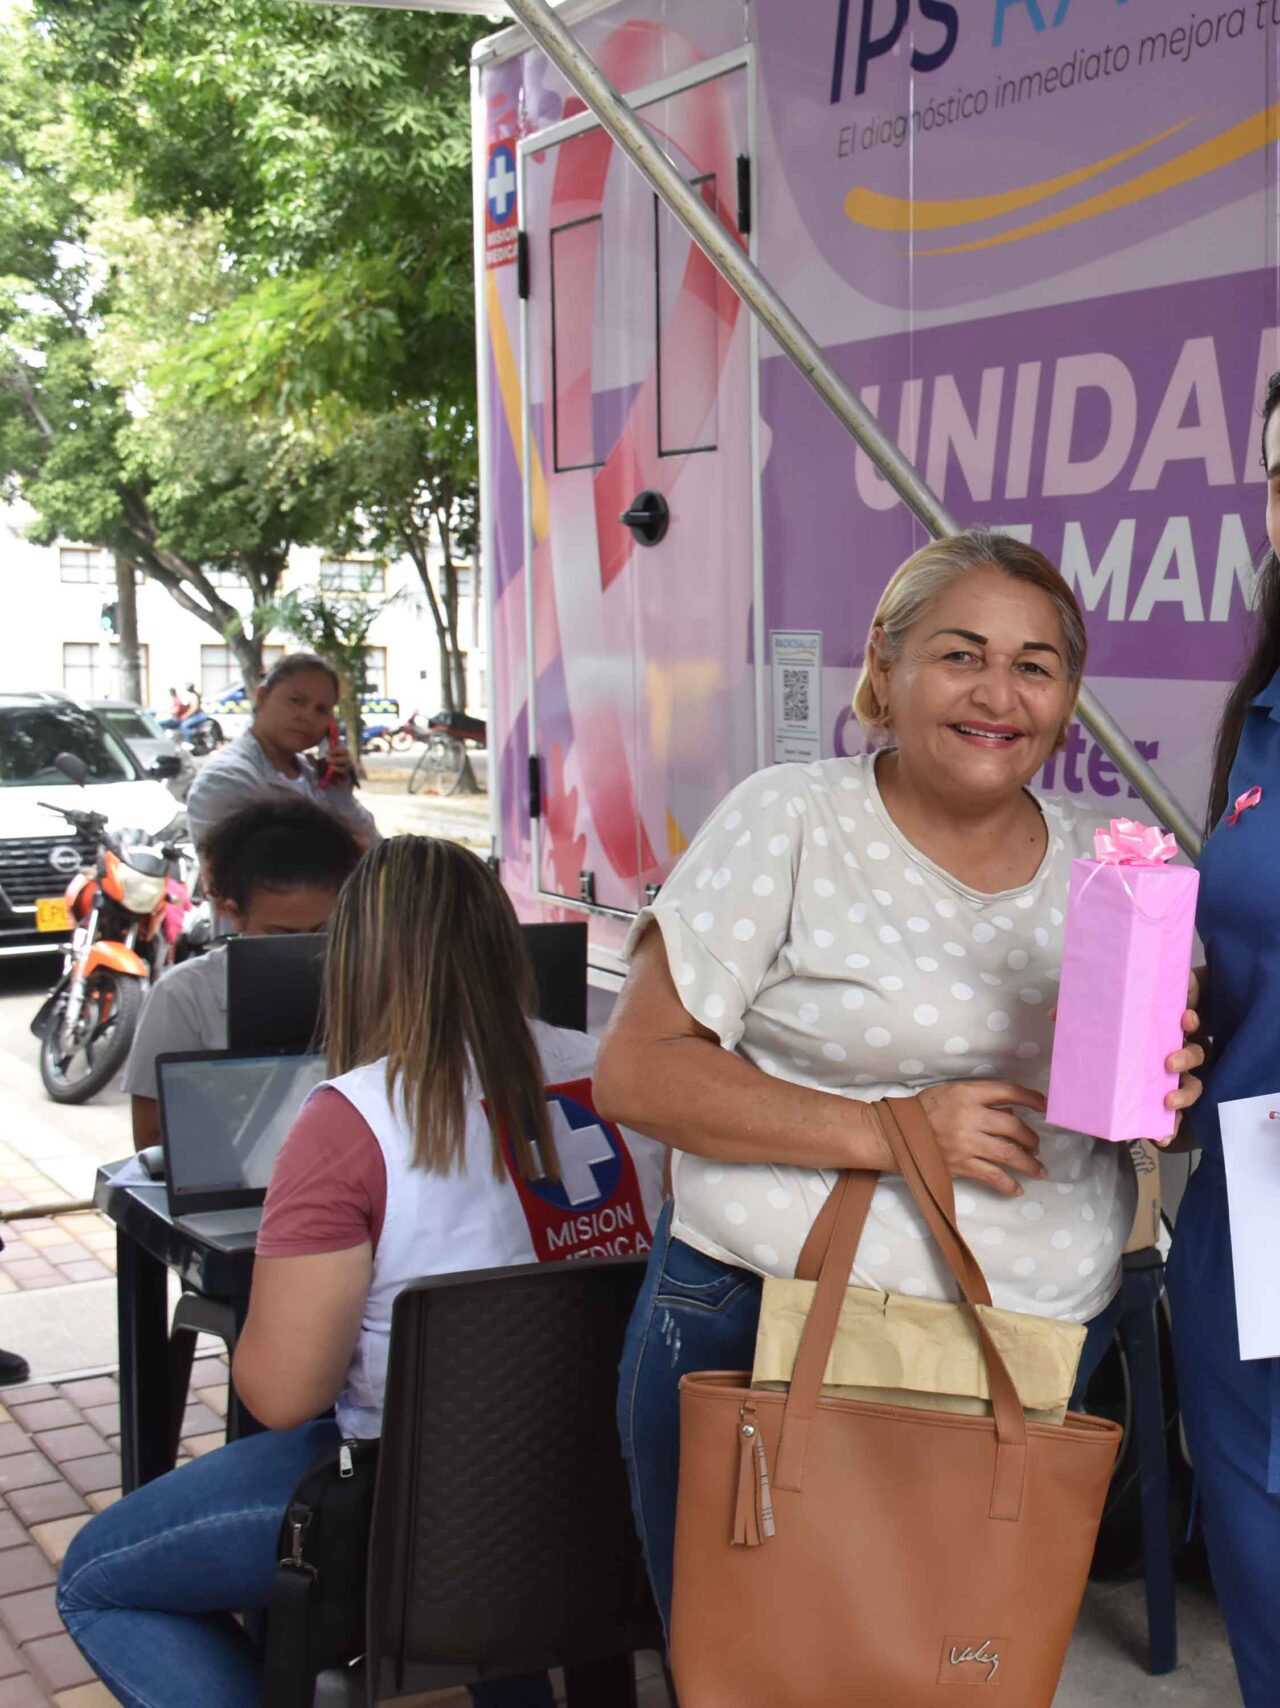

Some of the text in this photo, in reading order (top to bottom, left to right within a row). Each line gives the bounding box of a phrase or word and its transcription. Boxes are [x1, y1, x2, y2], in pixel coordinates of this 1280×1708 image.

[830, 0, 959, 105] IPS
[838, 122, 857, 159] El
[861, 88, 988, 150] diagnóstico
[995, 43, 1130, 109] inmediato
[1138, 7, 1246, 65] mejora
[546, 1201, 635, 1251] MISION
